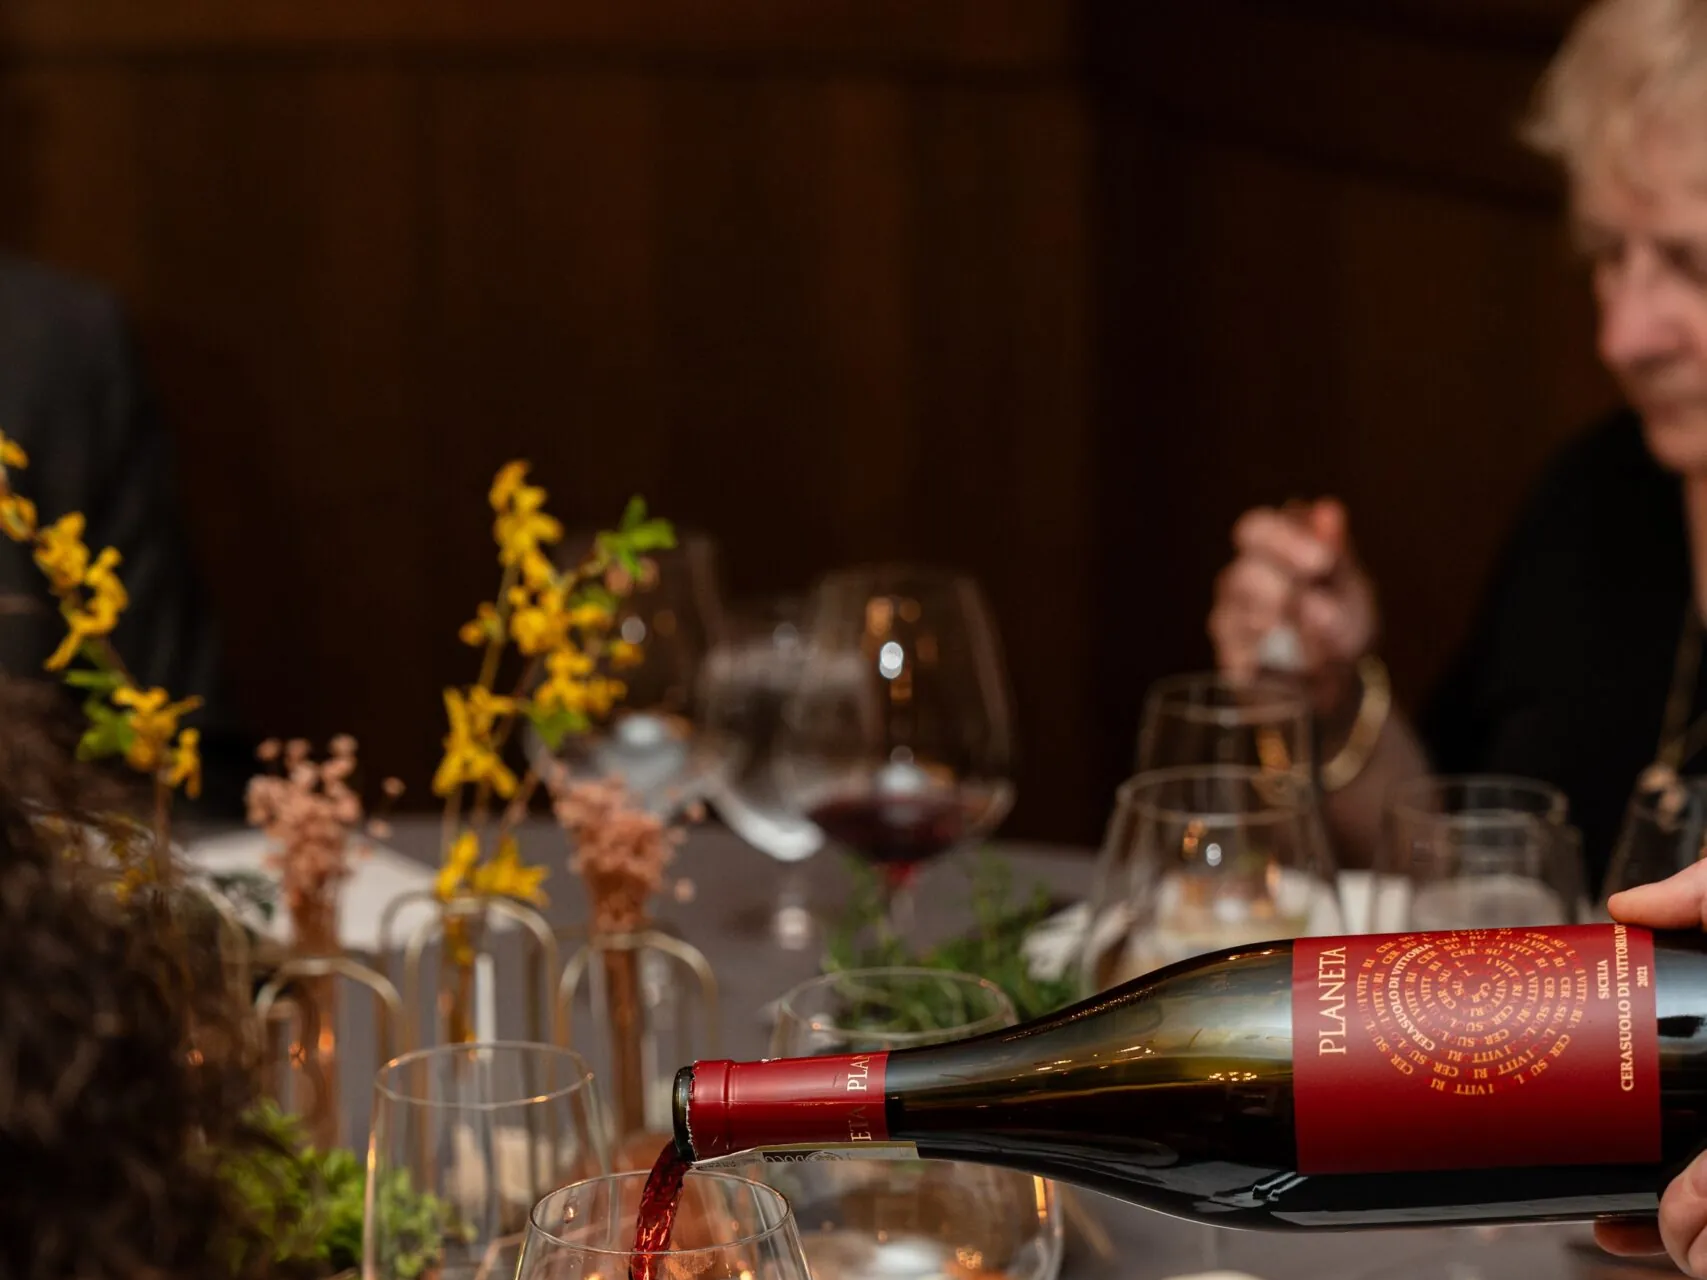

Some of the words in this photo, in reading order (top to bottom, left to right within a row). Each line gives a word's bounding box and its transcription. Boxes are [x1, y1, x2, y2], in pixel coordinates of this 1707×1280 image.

[1392, 944, 1433, 975] VITTORIA
[1597, 960, 1610, 1000] SICILIA
[1615, 934, 1629, 980] VITTORIA
[1319, 946, 1347, 1056] PLANETA
[1617, 982, 1630, 997] DI
[1389, 990, 1436, 1051] CERASUOLO
[1618, 1000, 1634, 1091] CERASUOLO
